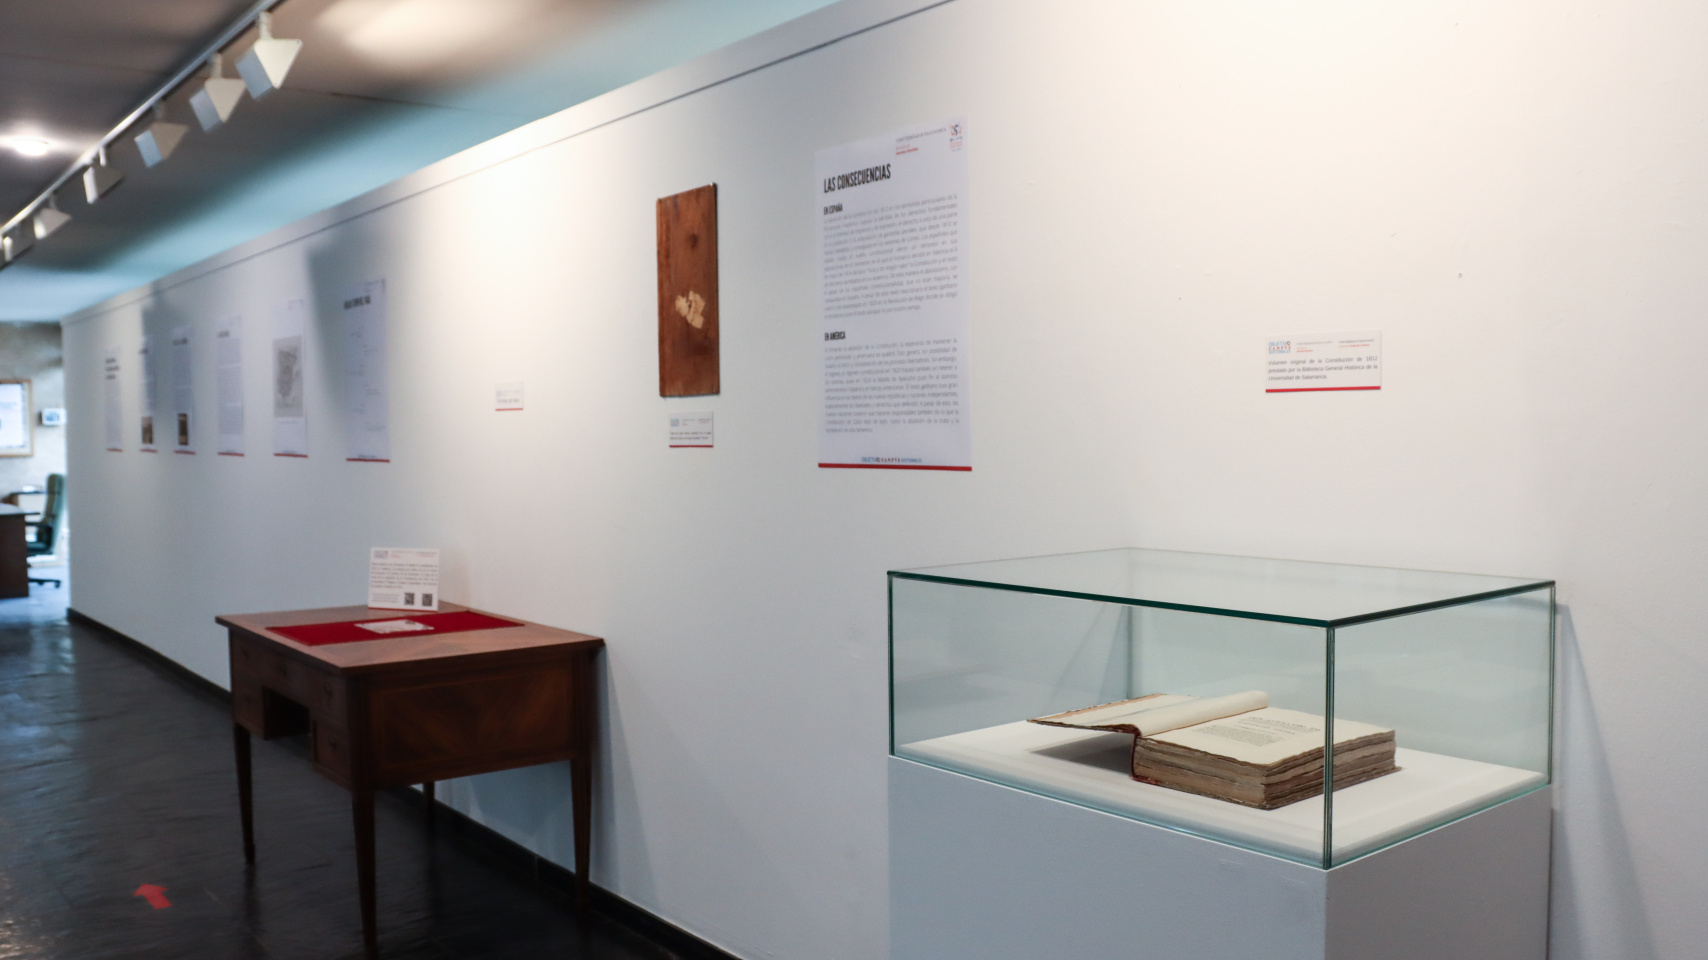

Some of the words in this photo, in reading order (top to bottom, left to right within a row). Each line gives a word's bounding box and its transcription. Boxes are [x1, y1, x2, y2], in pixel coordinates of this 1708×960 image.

[824, 177, 836, 194] LAS
[837, 163, 891, 190] CONSECUENCIAS
[824, 206, 828, 215] EN
[829, 202, 843, 214] ESPAÑA
